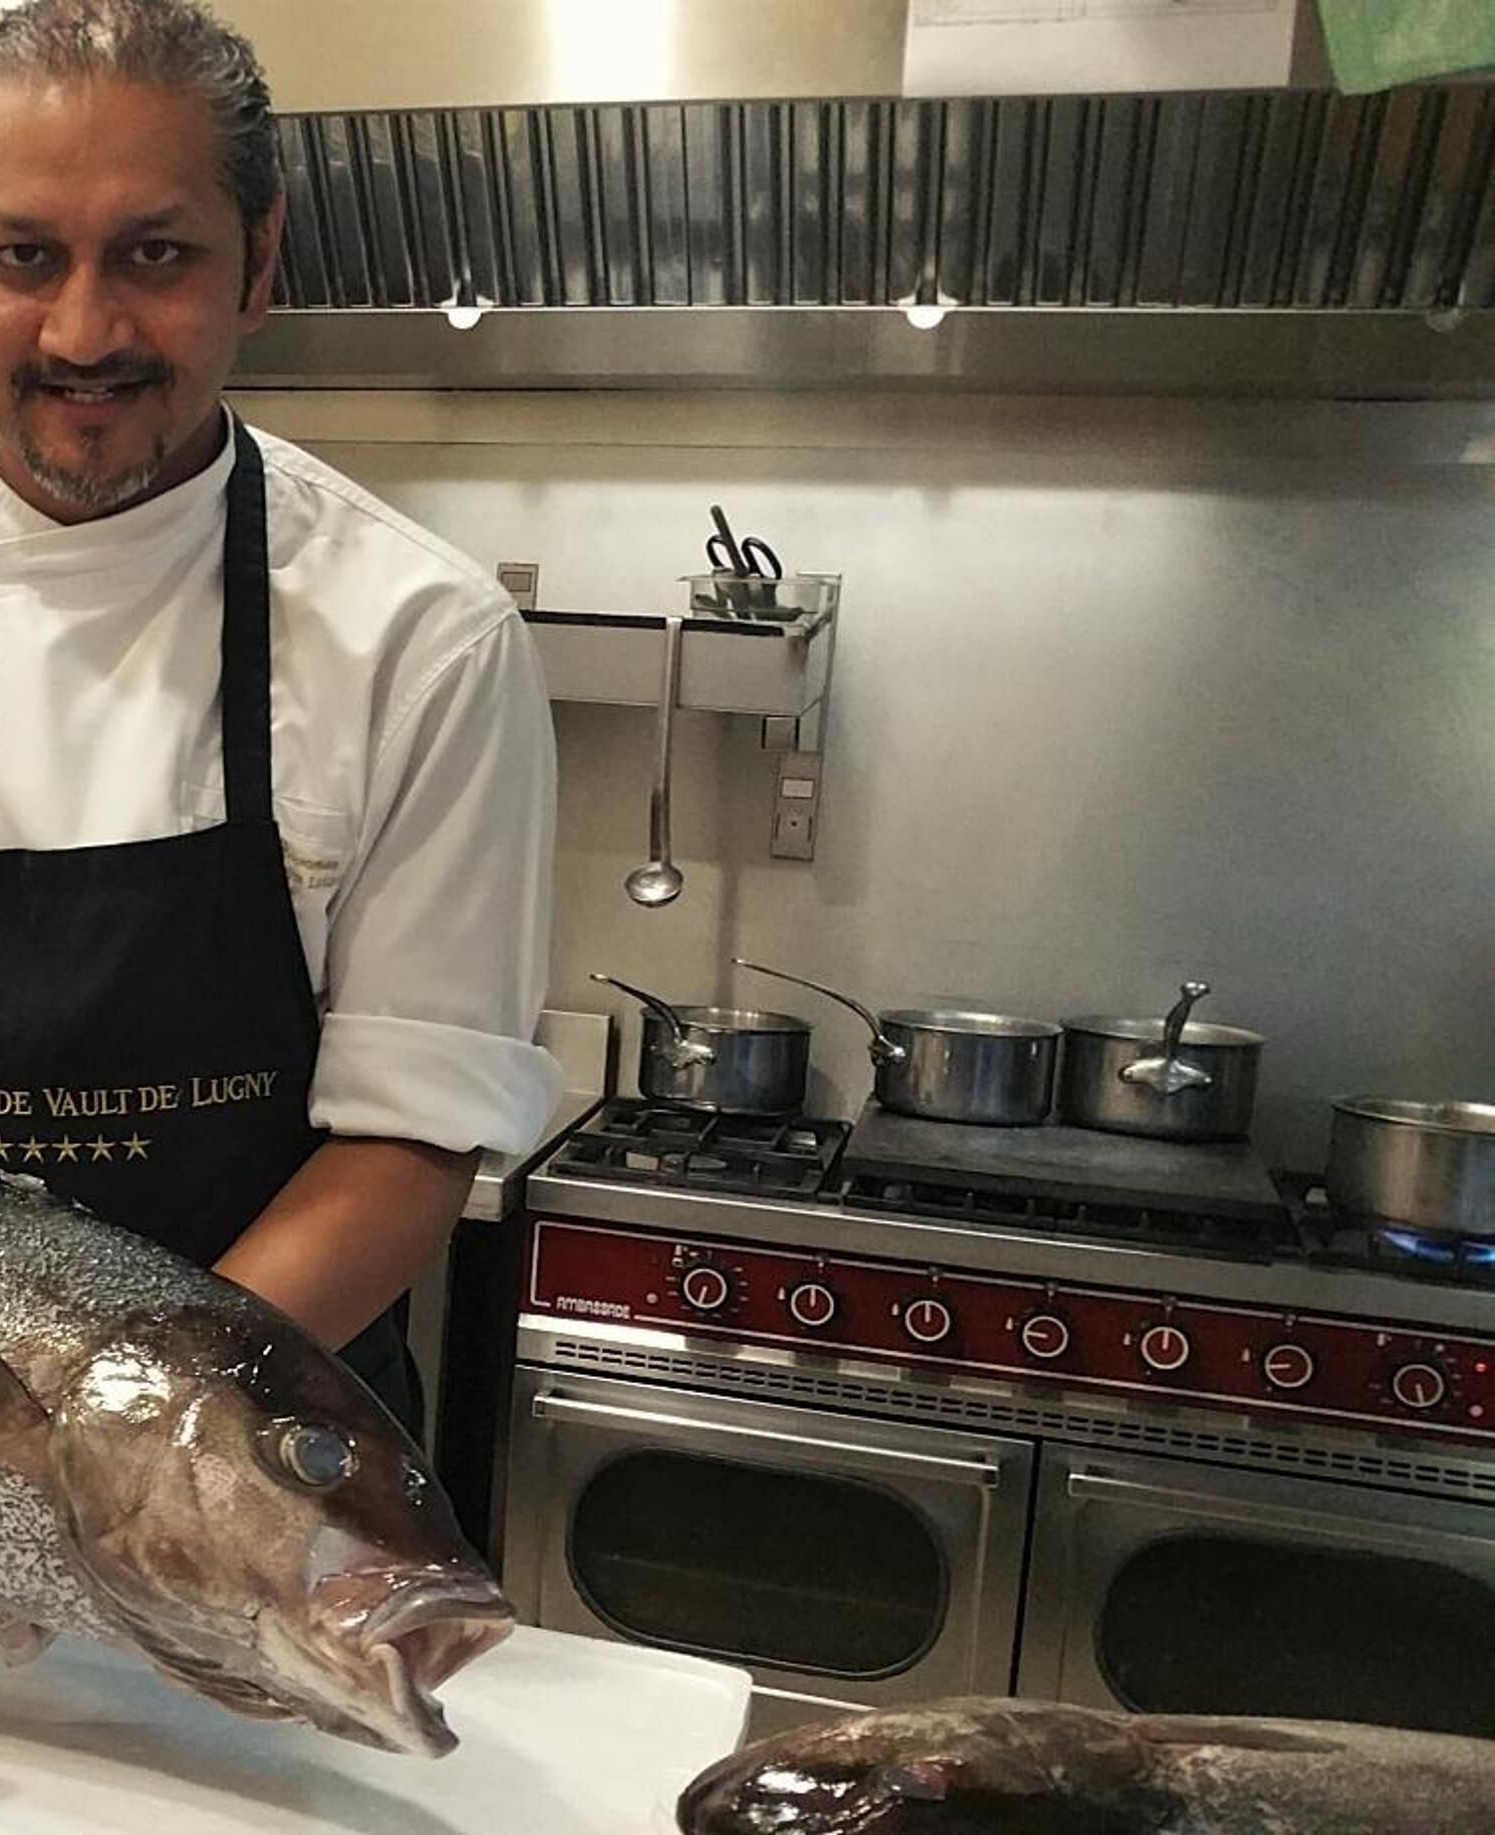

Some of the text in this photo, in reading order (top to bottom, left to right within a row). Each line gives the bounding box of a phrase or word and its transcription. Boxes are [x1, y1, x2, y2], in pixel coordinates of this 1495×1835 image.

[42, 1088, 133, 1117] VAULT
[138, 1085, 179, 1112] DE
[190, 1070, 277, 1108] LUGNY
